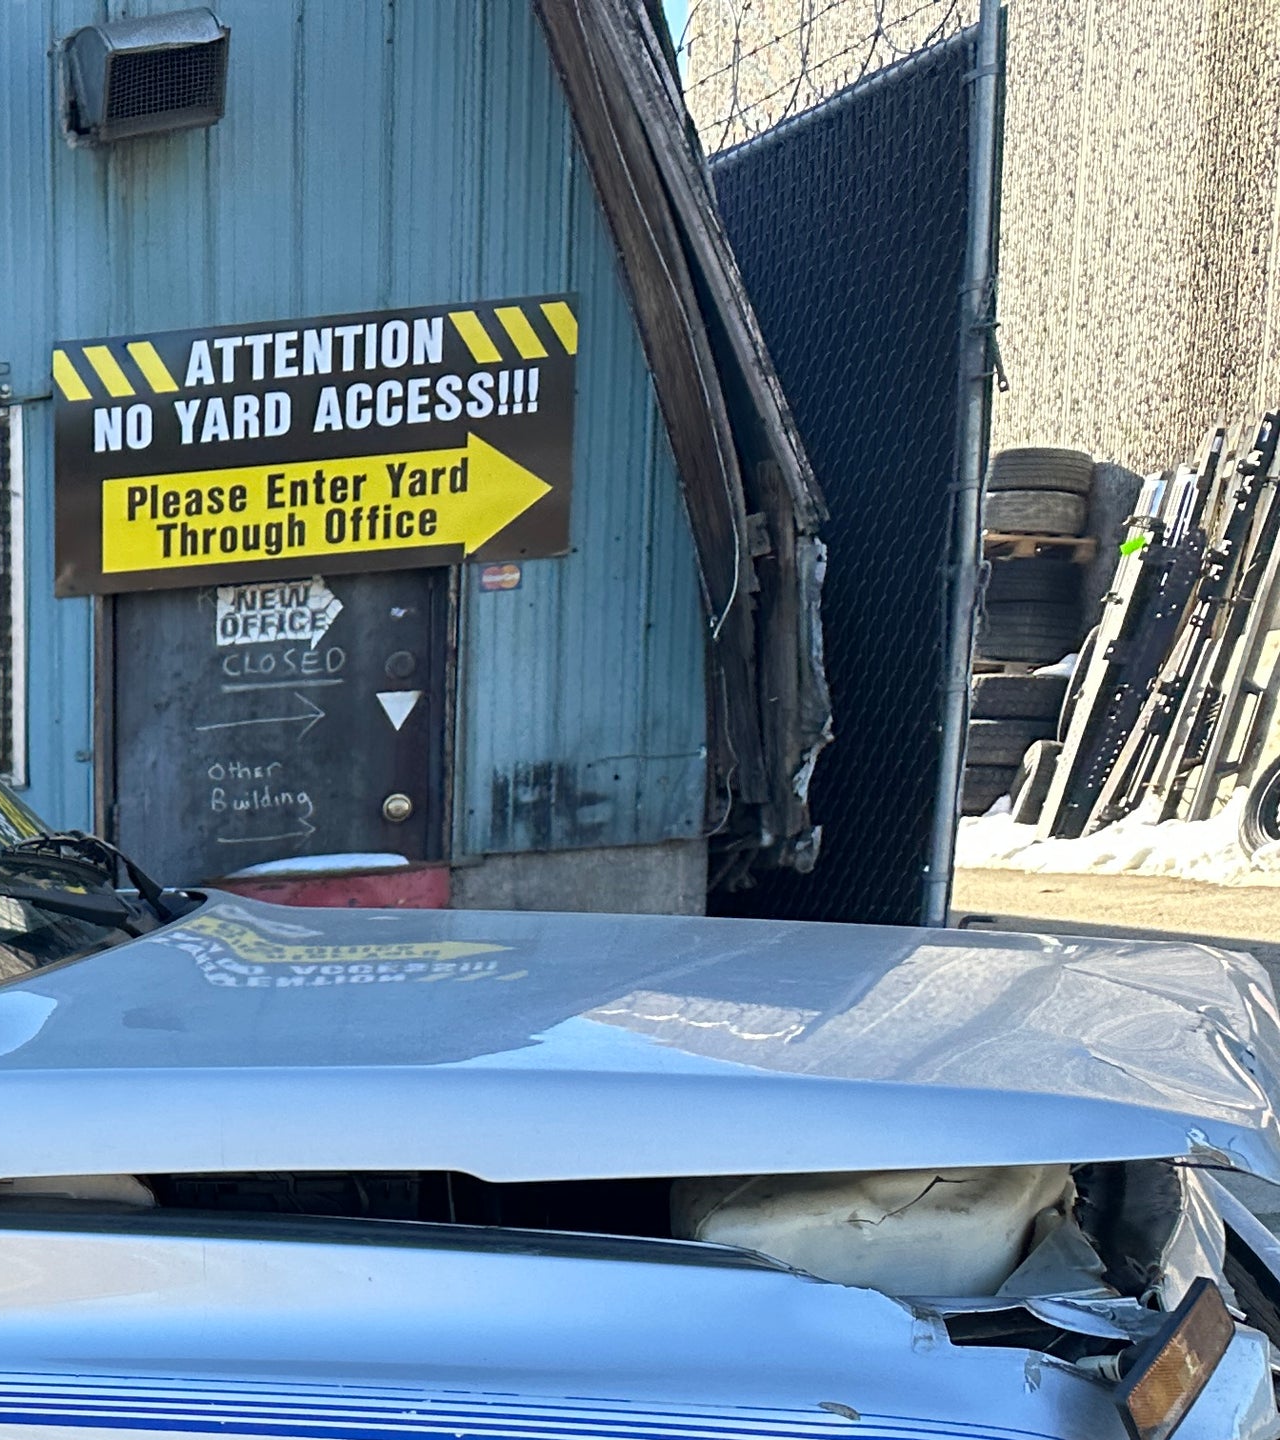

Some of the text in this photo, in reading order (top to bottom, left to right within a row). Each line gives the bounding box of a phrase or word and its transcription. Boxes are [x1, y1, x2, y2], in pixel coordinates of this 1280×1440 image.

[184, 317, 443, 388] ATTENTION
[93, 367, 540, 453] NO YARD ACCESS!!!
[127, 457, 470, 522] Please Enter Yard
[156, 506, 438, 557] Through Office
[233, 583, 311, 611] NEW
[220, 609, 329, 639] OFFICE
[222, 647, 346, 676] CLOSED
[207, 761, 283, 781] Other
[211, 785, 313, 819] Building
